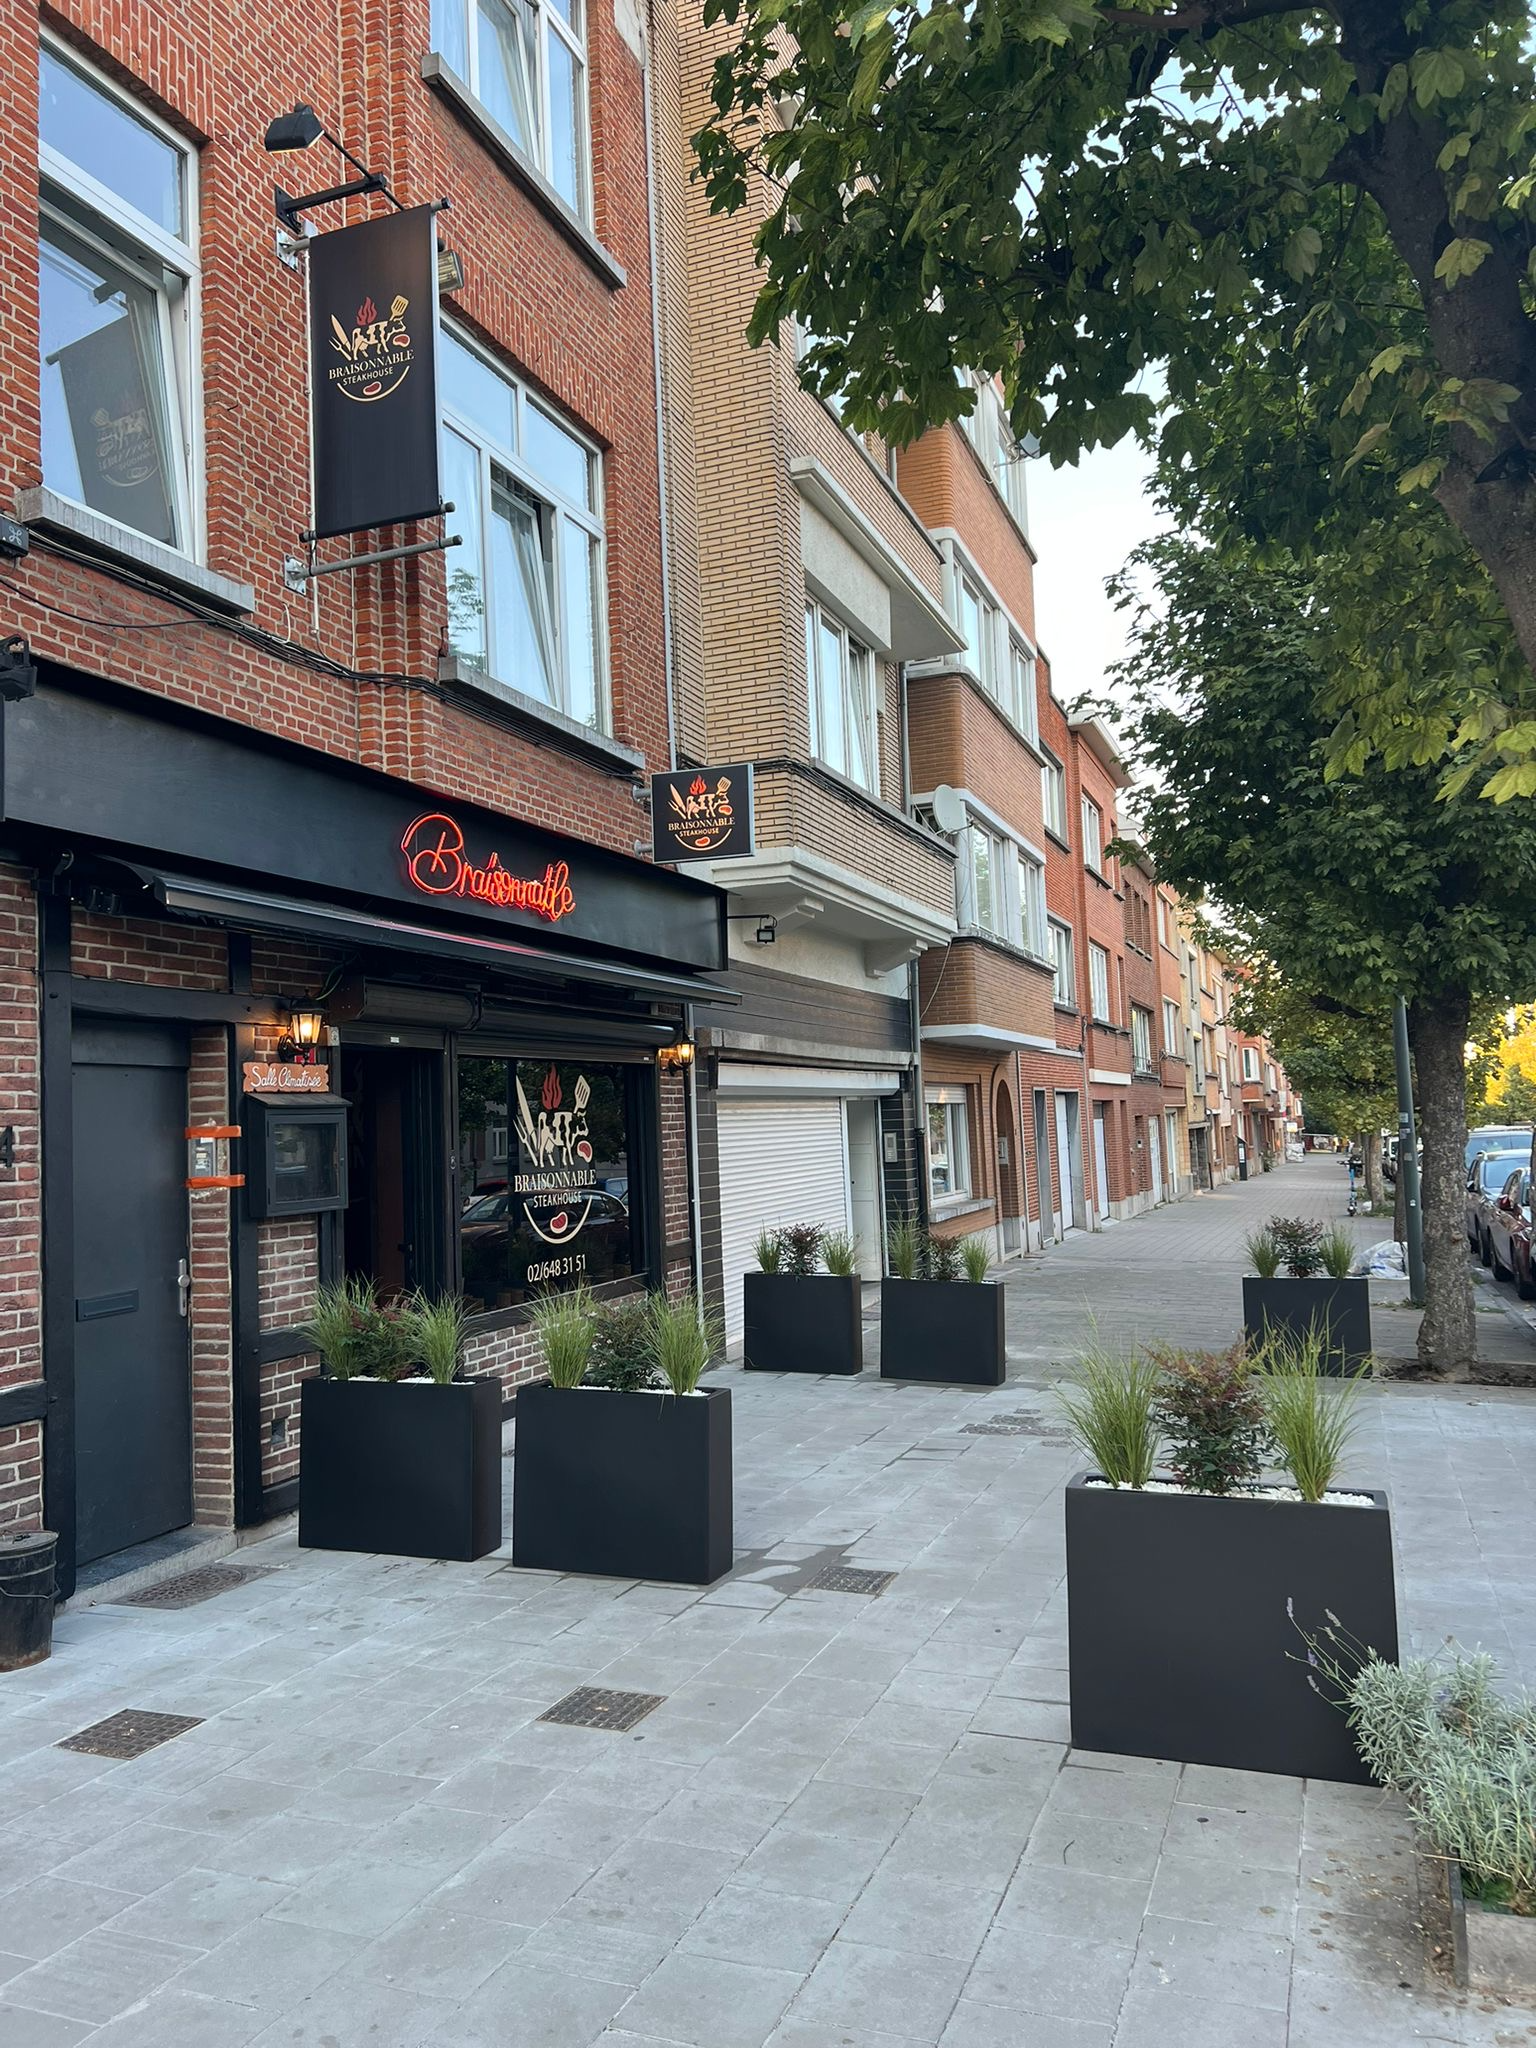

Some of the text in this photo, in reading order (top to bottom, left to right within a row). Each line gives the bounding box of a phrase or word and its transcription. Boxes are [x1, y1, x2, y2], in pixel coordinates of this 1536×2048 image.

[329, 349, 415, 380] BRAISONNABLE
[343, 366, 394, 386] STEAKHOUSE
[668, 817, 735, 831] BRAISONNABLE
[679, 828, 719, 838] STEAKHOUSE
[402, 813, 576, 920] Braisonnable
[250, 1065, 323, 1088] Salle Climatisée
[514, 1169, 597, 1193] BRAISONNABLE
[533, 1191, 582, 1208] STEAKHOUSE
[527, 1254, 586, 1283] 02/648 31 51
